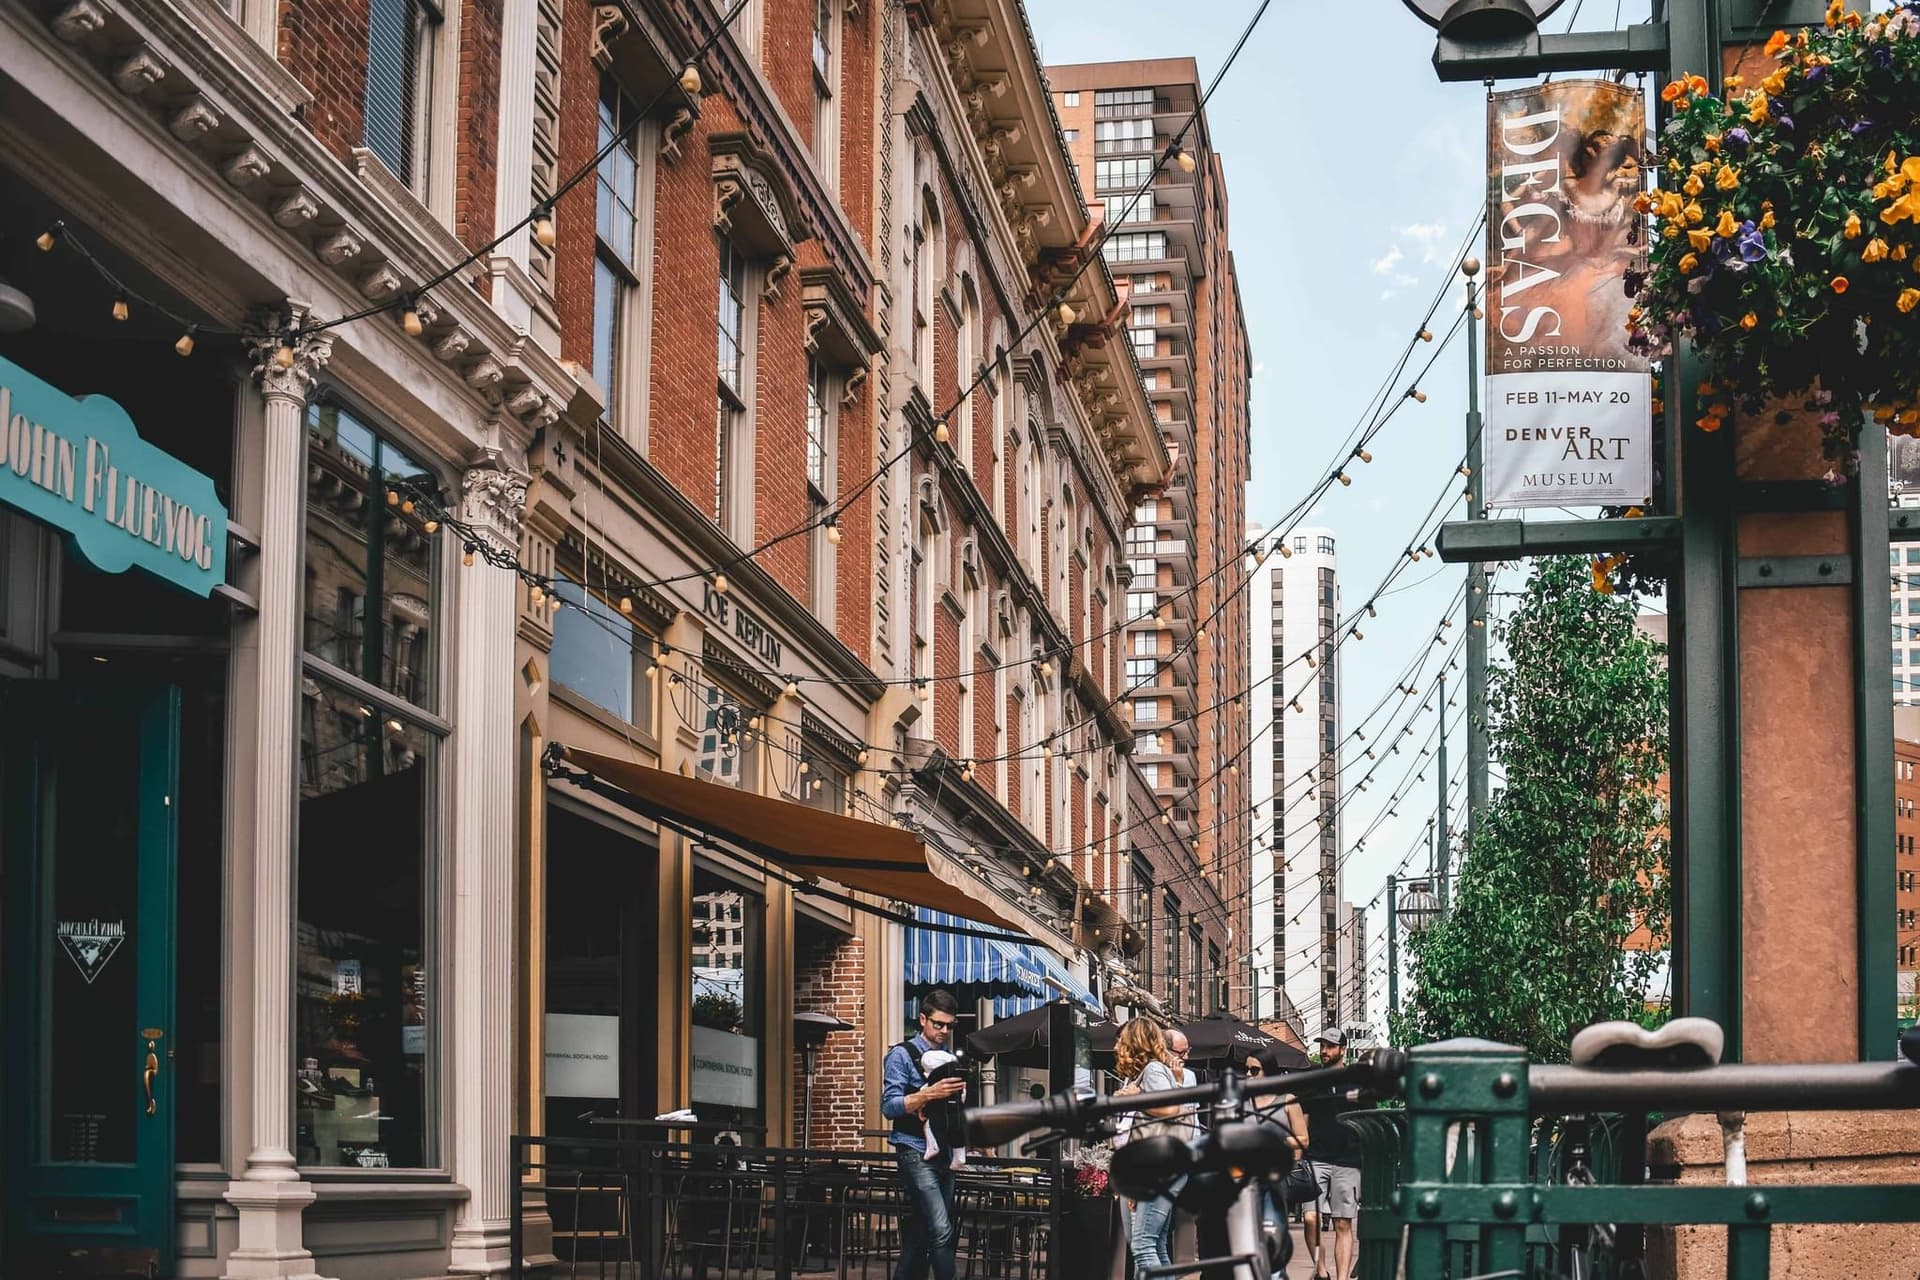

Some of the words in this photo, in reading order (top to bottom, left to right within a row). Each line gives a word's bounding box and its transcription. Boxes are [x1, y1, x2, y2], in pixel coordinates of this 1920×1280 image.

[1499, 104, 1561, 343] DEGAS
[1504, 347, 1513, 357] A
[1519, 345, 1580, 356] PASSION
[1504, 359, 1532, 370] FOR
[1537, 358, 1627, 370] PERFECTION
[1506, 391, 1538, 405] FEB
[1609, 390, 1630, 404] 20
[1506, 426, 1591, 441] DENVER
[1561, 437, 1631, 461] ART
[0, 386, 77, 502] JOHN
[82, 436, 212, 570] FLUEVOG
[1522, 472, 1613, 487] MUSEUM
[702, 581, 729, 626] JOE
[735, 608, 782, 668] REPLIN
